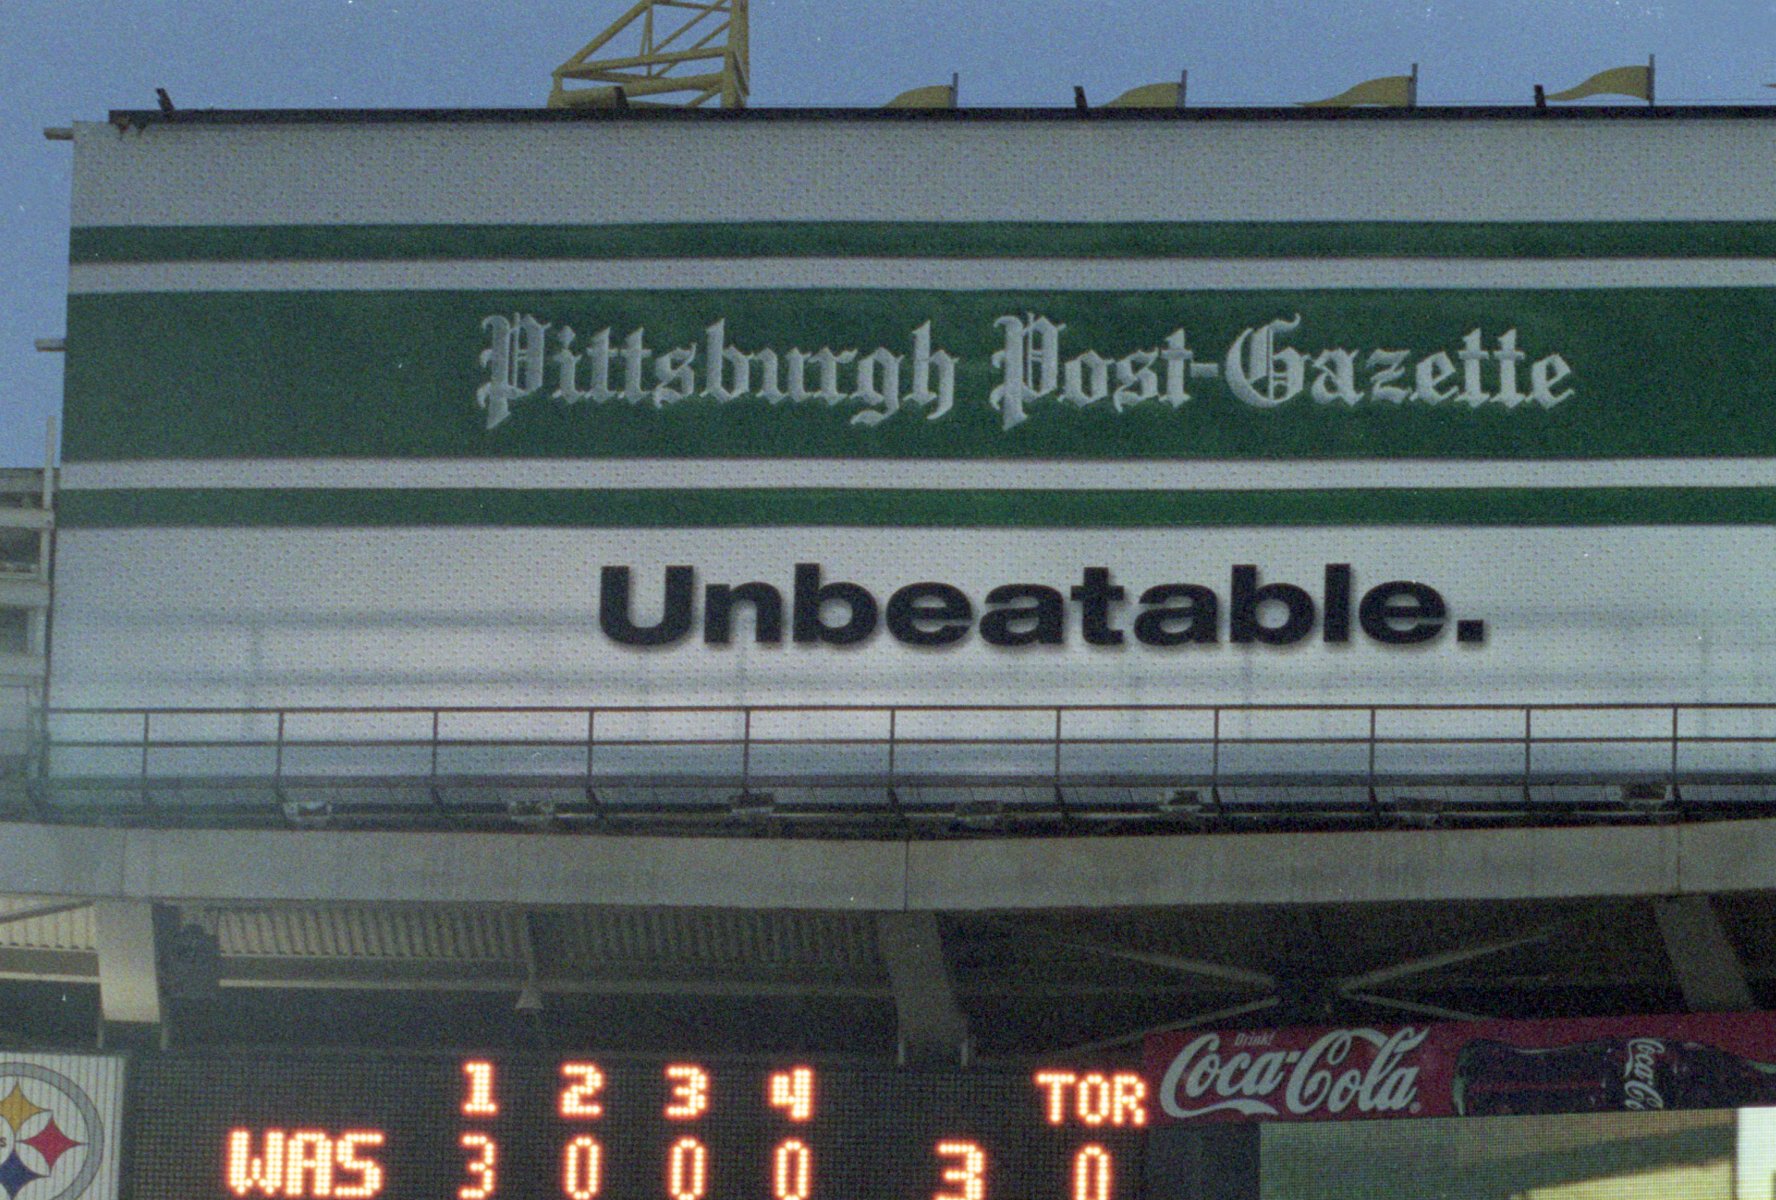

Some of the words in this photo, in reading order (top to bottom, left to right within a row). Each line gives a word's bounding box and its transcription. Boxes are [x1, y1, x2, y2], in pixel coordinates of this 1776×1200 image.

[478, 314, 958, 429] Pittsburgh
[993, 313, 1574, 429] Post-Gazette
[600, 564, 1485, 648] Unbeatable.
[460, 1059, 500, 1117] 1
[558, 1061, 606, 1119] 2
[663, 1063, 711, 1121] 3
[768, 1066, 815, 1123] 4
[1034, 1069, 1148, 1128] TOR
[1160, 1026, 1431, 1118] Coca-Cola
[224, 1126, 386, 1200] WAS
